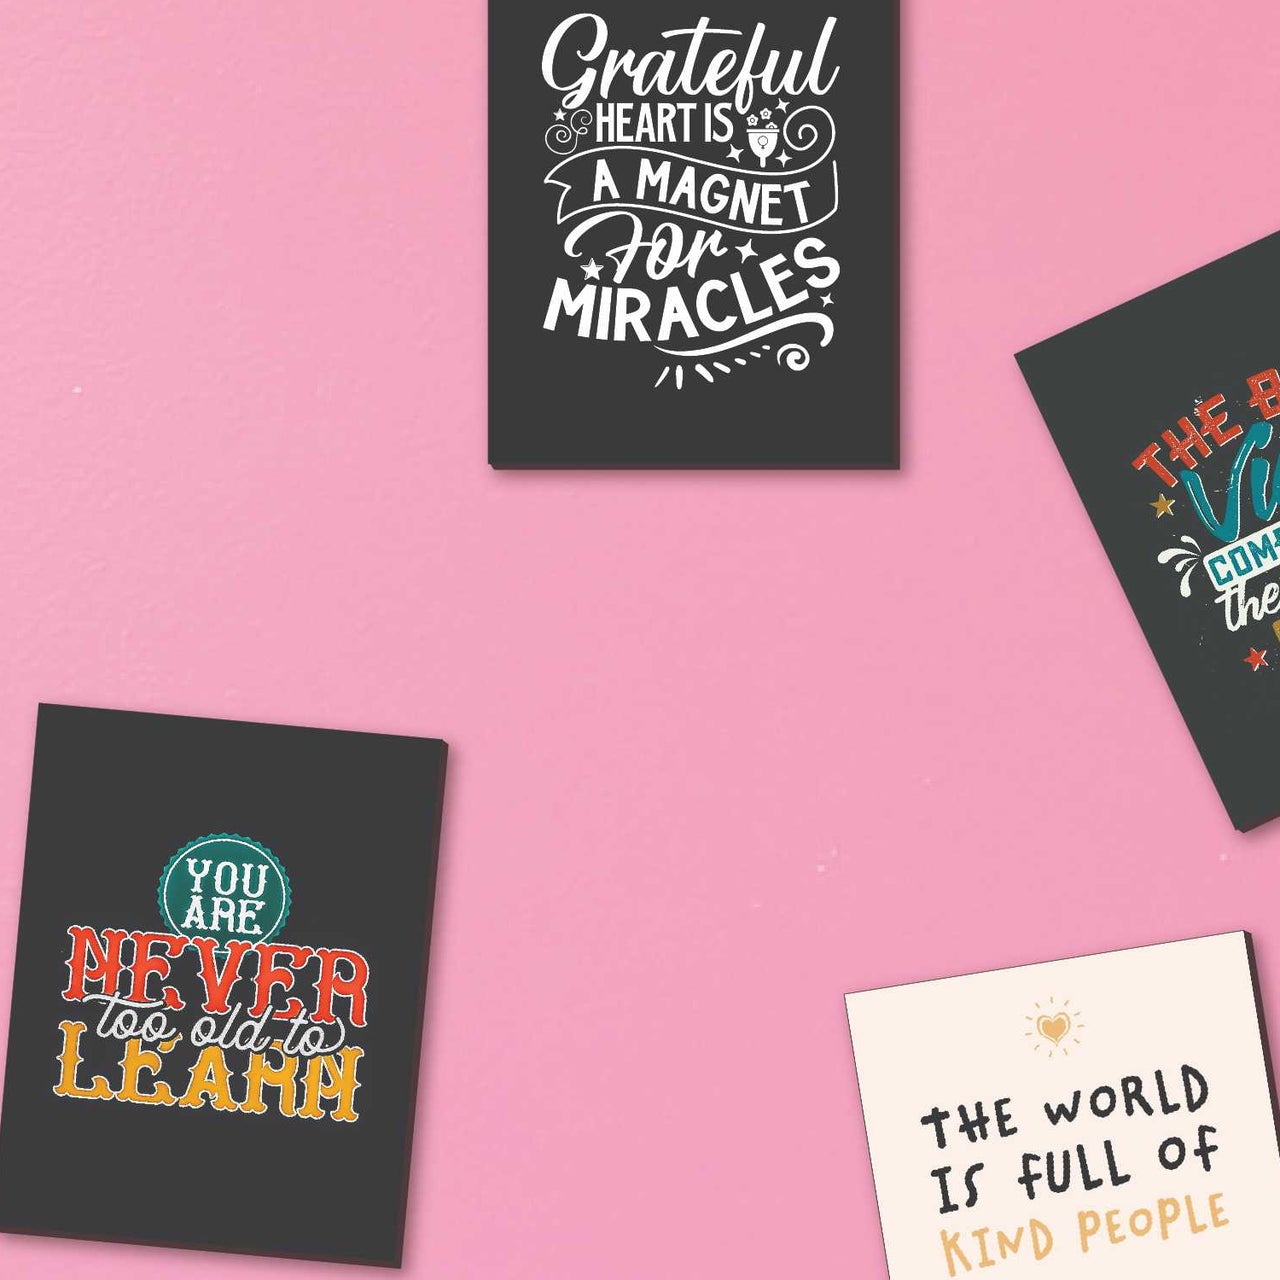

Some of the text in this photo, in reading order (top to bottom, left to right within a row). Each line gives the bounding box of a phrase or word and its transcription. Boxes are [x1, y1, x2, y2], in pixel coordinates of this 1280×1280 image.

[541, 12, 840, 115] Grateful
[595, 102, 734, 143] HEART IS
[593, 158, 811, 226] A MAGNET
[542, 237, 841, 342] MIRACLES
[563, 211, 728, 284] For
[1132, 394, 1244, 487] THE
[181, 895, 266, 935] ARE
[186, 858, 269, 898] YOU
[61, 925, 370, 1028] NEVER
[53, 1021, 365, 1123] LEARN
[190, 1003, 274, 1053] old
[273, 1008, 345, 1058] to
[920, 1064, 1209, 1149] THE WORLD
[930, 1125, 1219, 1214] IS FULL OF
[939, 1192, 1230, 1277] KIND PEOPLE
